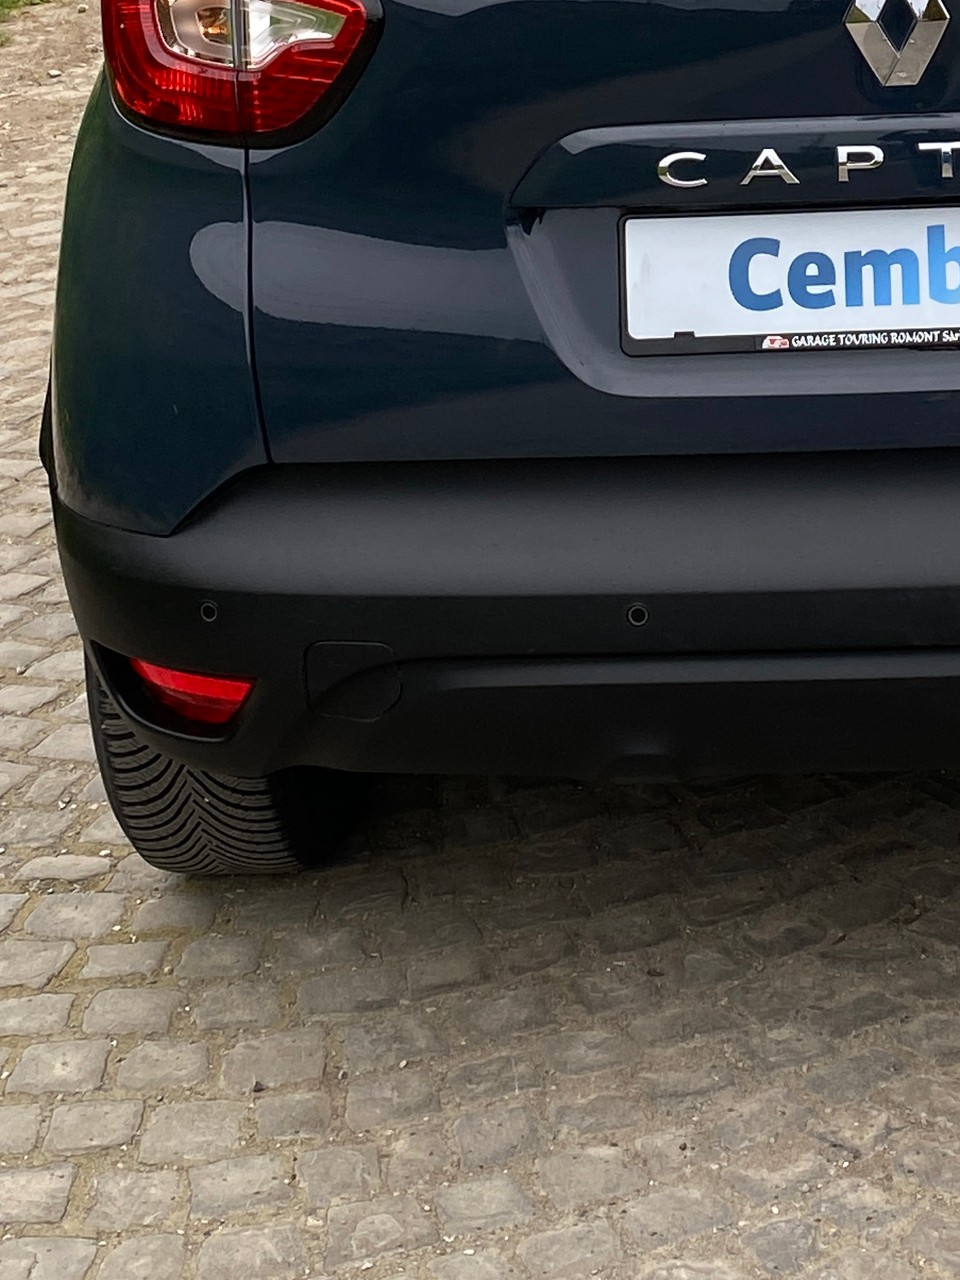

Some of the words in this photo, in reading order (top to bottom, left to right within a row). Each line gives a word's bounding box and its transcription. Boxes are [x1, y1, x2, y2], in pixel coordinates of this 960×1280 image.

[791, 334, 836, 347] GARAGE
[838, 332, 888, 346] TOURING
[890, 330, 941, 343] ROMONT
